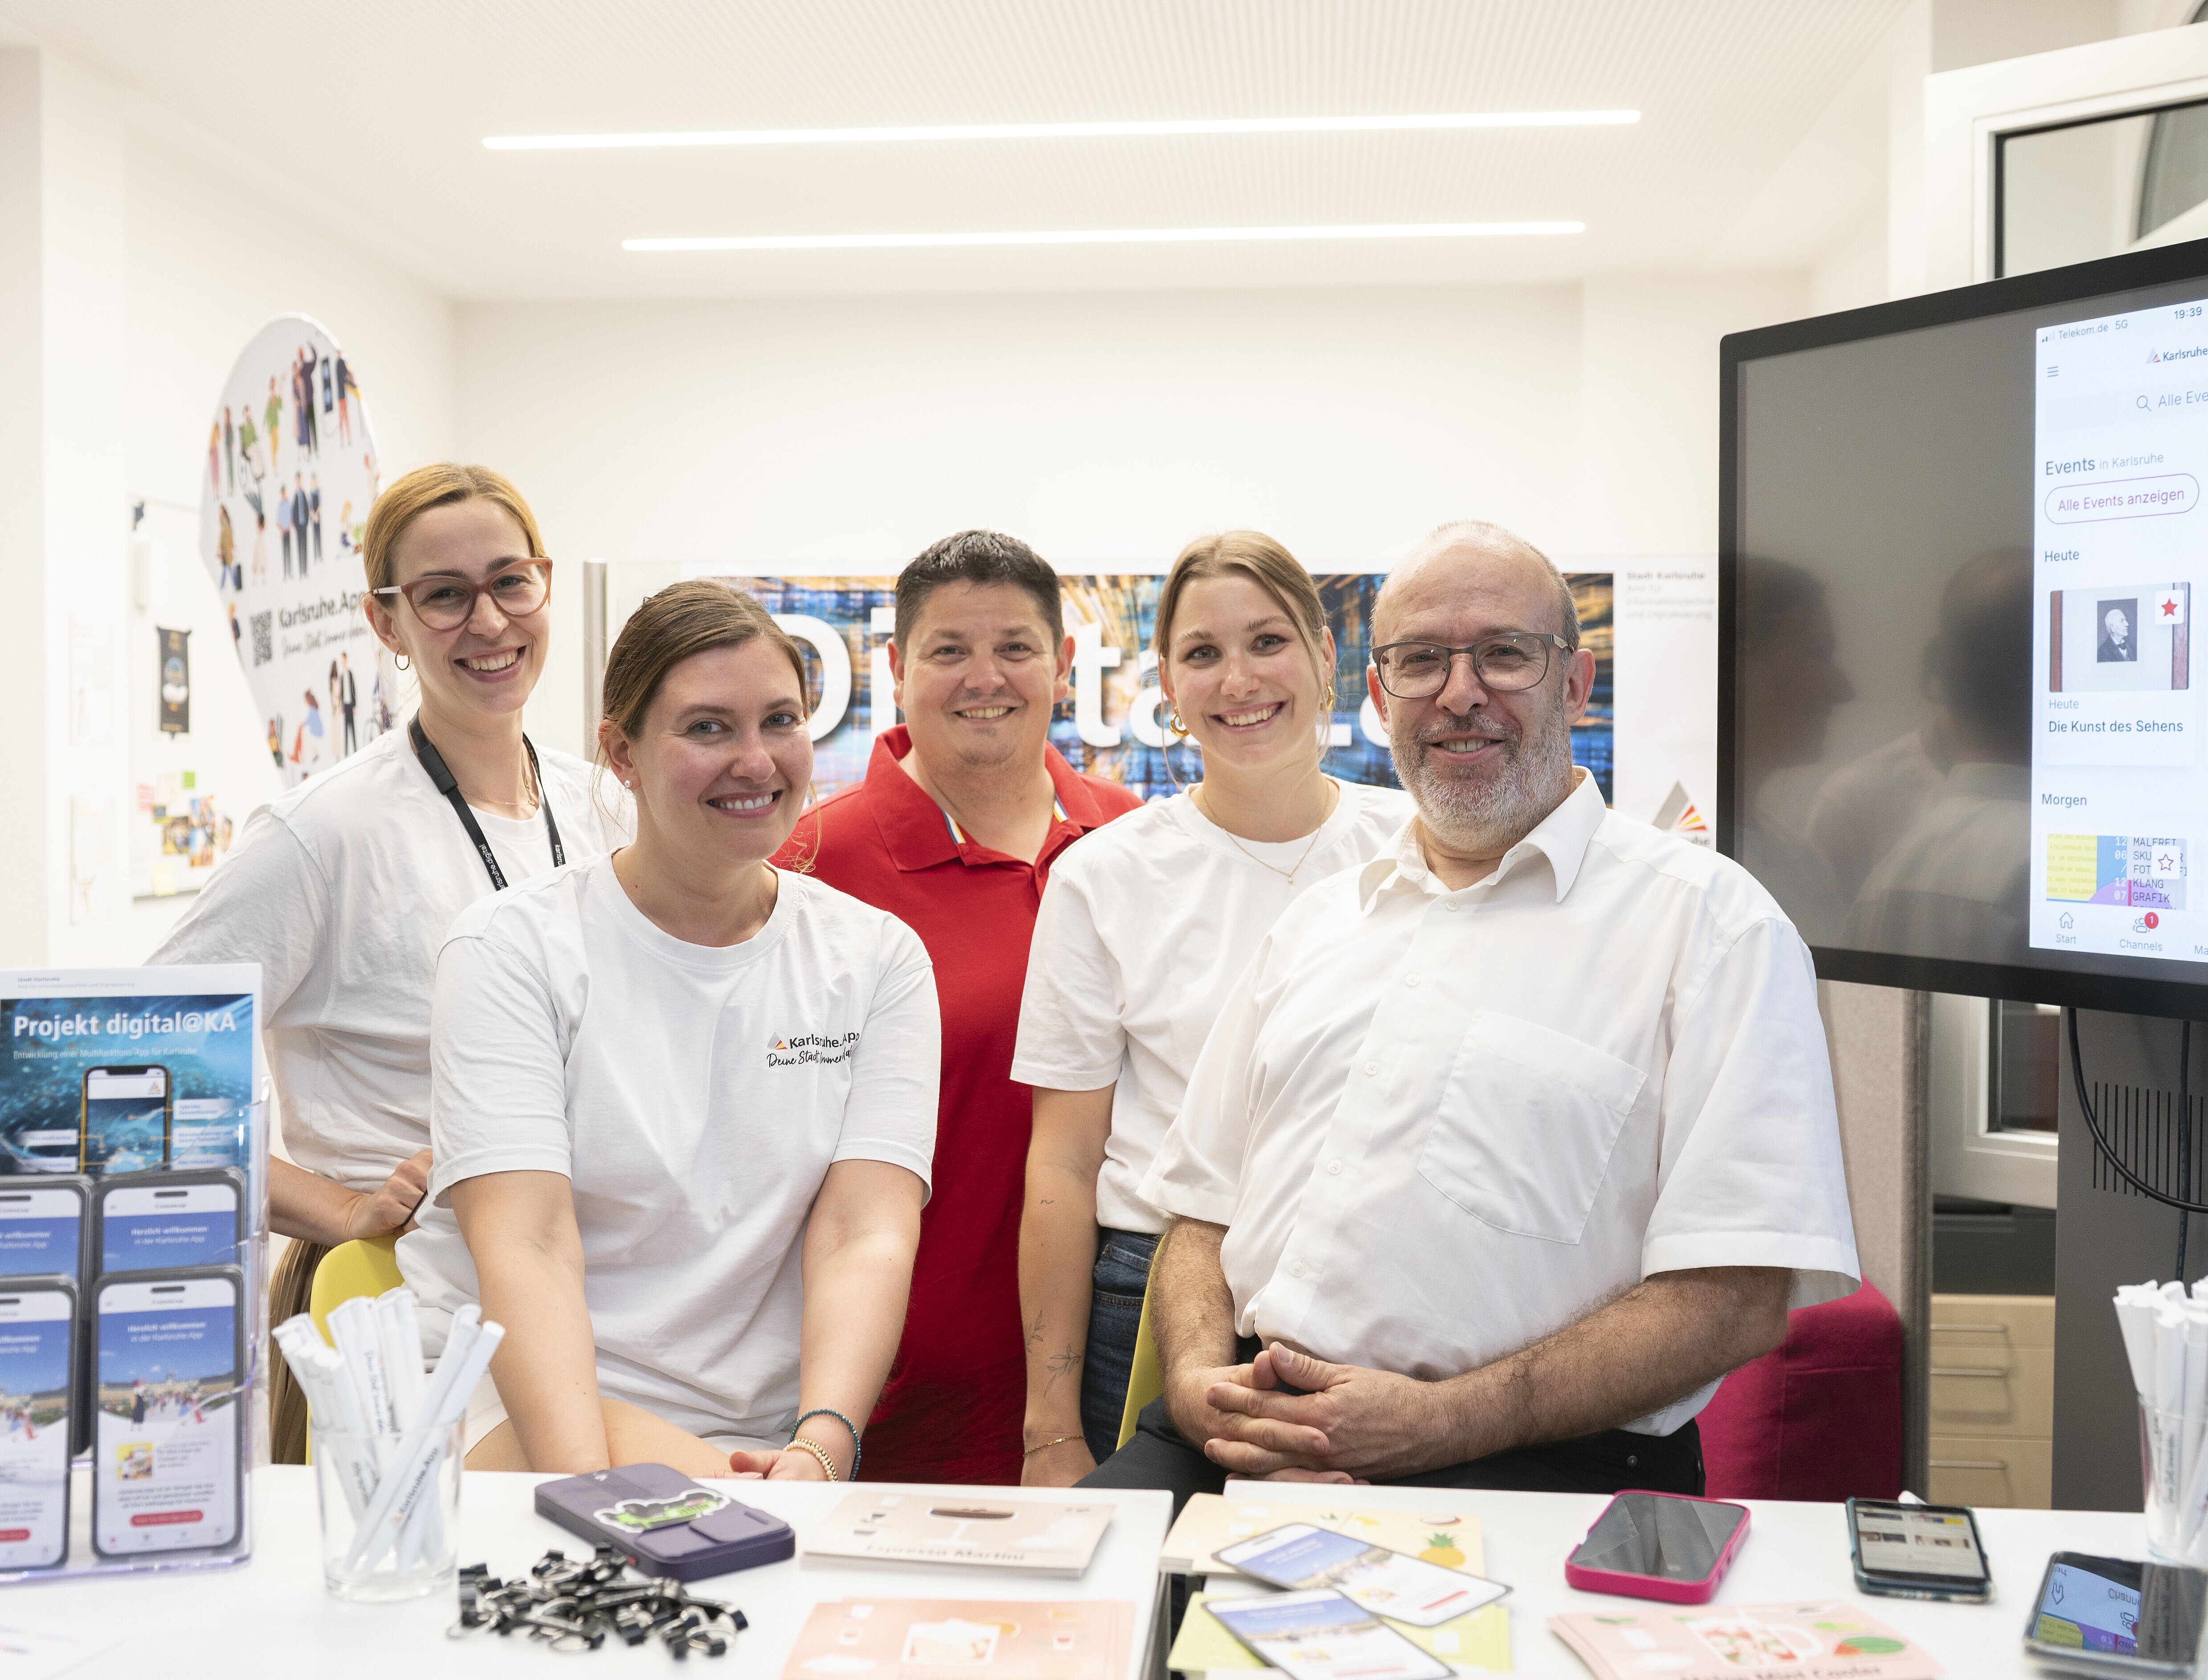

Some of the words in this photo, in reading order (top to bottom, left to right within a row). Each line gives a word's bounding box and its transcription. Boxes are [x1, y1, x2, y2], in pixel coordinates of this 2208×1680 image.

[2174, 307, 2202, 320] 19:39
[2058, 324, 2108, 339] Telekom.de
[2115, 320, 2128, 330] 5G
[2159, 393, 2182, 407] Alle
[2046, 458, 2095, 475] Events
[2099, 459, 2108, 470] in
[2112, 453, 2164, 468] Karlsruhe
[2058, 500, 2080, 512] Alle
[2084, 496, 2123, 509] Events
[2127, 489, 2184, 505] anzeigen
[2044, 549, 2080, 562] Heute
[2049, 698, 2079, 709] Heute
[2049, 721, 2067, 733] Die
[2071, 721, 2106, 732] Kunst
[2110, 720, 2131, 732] des
[2136, 720, 2183, 733] Sehens
[2042, 793, 2087, 808] Morgen
[2115, 836, 2127, 846] 12
[2115, 849, 2127, 860] 06
[2115, 877, 2126, 887] 12
[2133, 878, 2164, 889] KLANG
[2114, 890, 2126, 901] 07
[2133, 892, 2170, 903] GRAFIK
[2056, 934, 2077, 944] Start
[2119, 939, 2163, 951] Channels
[14, 1014, 100, 1041] Projekt
[106, 1012, 236, 1040] digital@KA
[13, 1050, 57, 1060] Entwicklung
[163, 1047, 197, 1055] Karlsruhe
[767, 1053, 797, 1068] Deine
